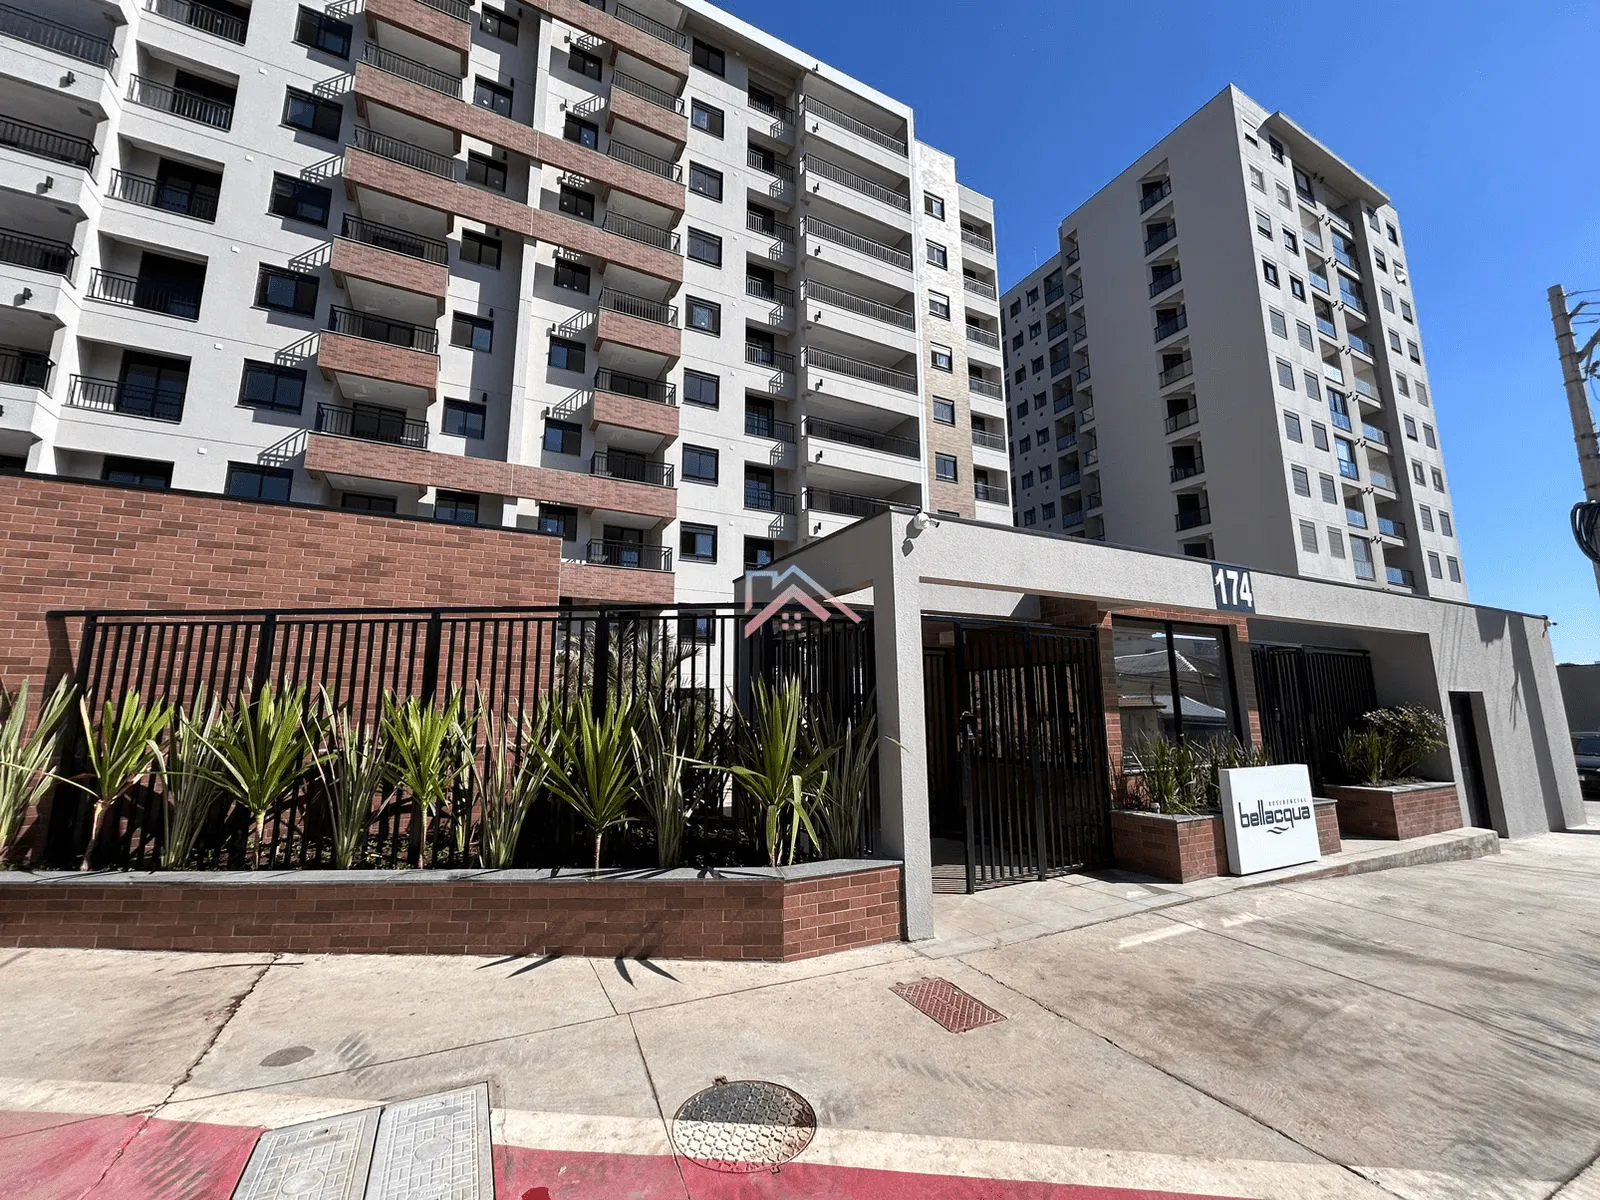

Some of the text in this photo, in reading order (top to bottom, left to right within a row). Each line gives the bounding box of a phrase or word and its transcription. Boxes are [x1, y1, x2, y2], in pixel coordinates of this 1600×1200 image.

[1214, 568, 1253, 607] 174
[1238, 799, 1311, 828] bellacqua
[1268, 797, 1307, 807] RESIDENCIAL
